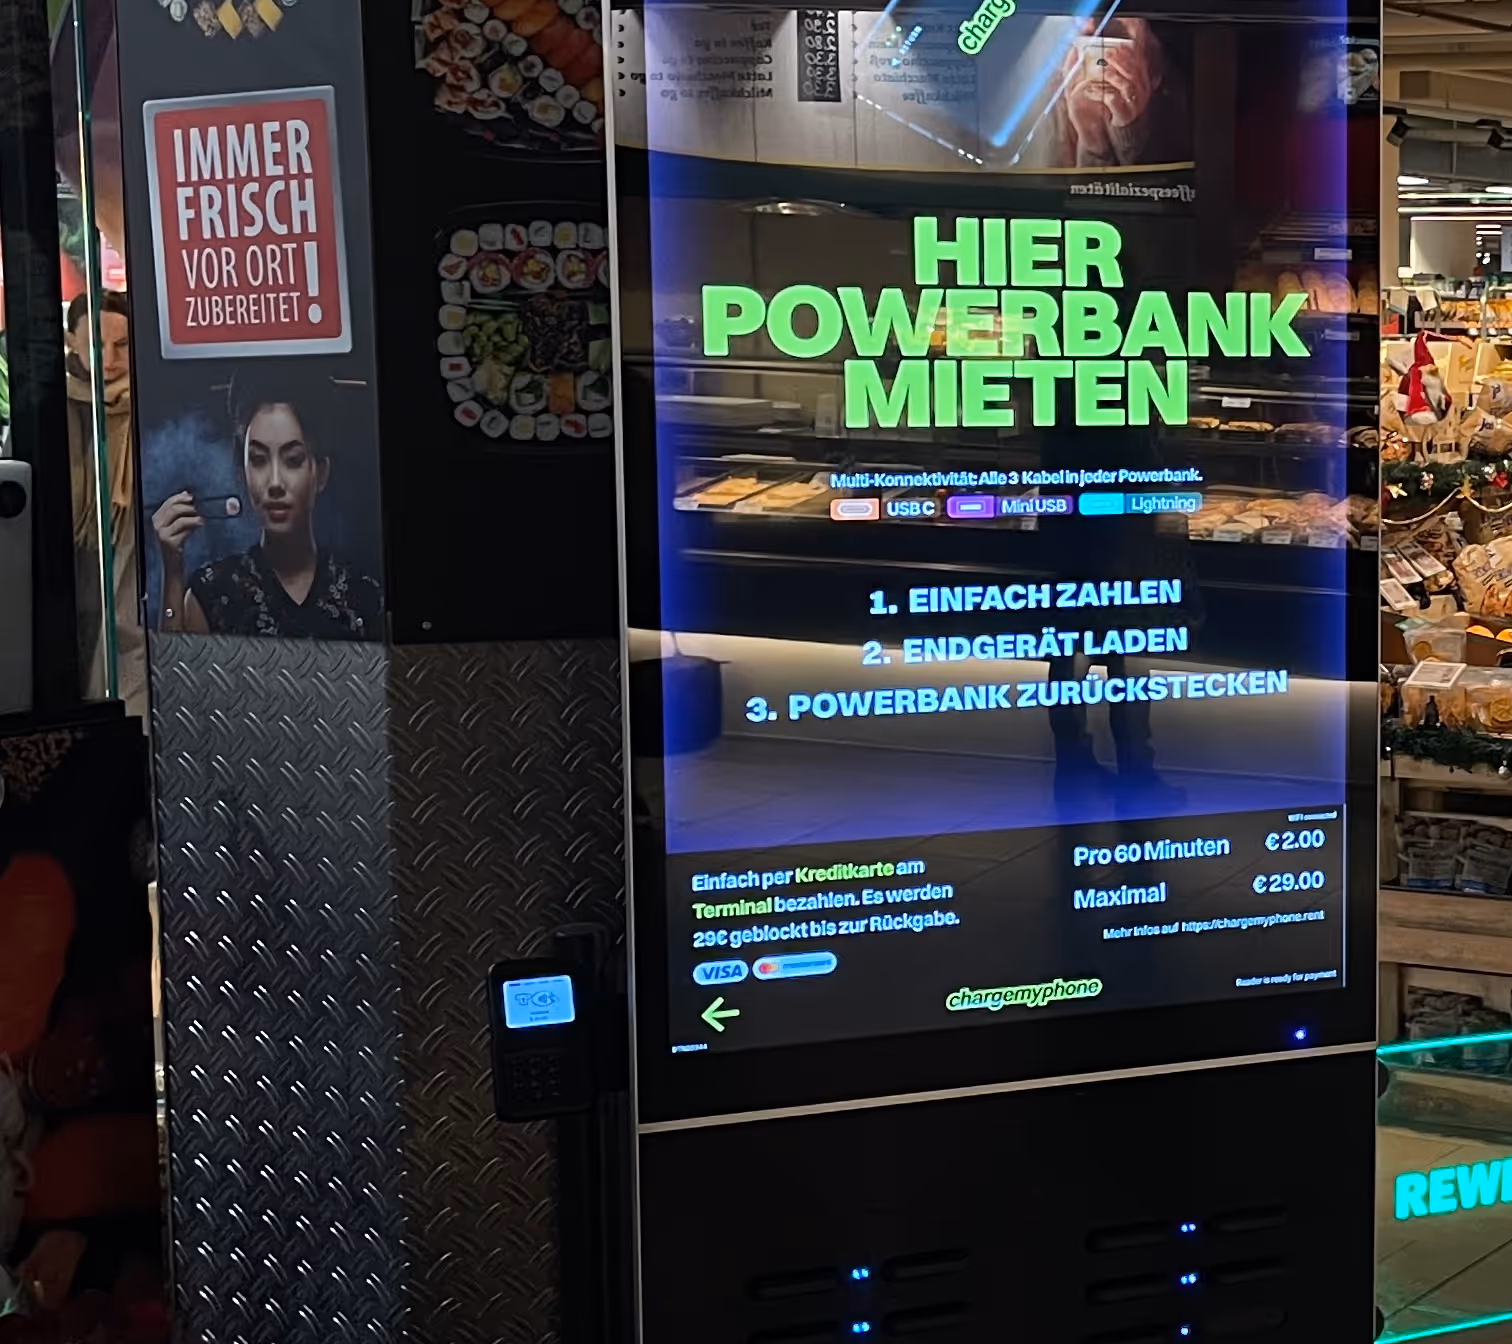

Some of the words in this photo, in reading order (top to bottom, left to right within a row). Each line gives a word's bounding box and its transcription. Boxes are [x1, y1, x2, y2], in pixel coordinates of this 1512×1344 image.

[173, 119, 313, 183] IMMER
[176, 177, 317, 242] FRISCH
[182, 247, 239, 290] VOR
[245, 243, 298, 286] ORT
[913, 215, 1123, 288] HIER
[185, 290, 302, 329] ZUBEREITET
[702, 285, 1311, 359] POWERBANK
[844, 359, 1188, 429] MIETEN
[830, 472, 977, 488] Multi-Konnektivität:
[978, 471, 1008, 485] Alle
[1008, 472, 1019, 485] 3
[1021, 470, 1065, 484] Kabel
[1065, 470, 1079, 484] in
[1079, 470, 1117, 486] jeder
[1118, 468, 1203, 484] Powerbank.
[887, 501, 918, 516] USB
[921, 501, 935, 515] C
[1002, 498, 1033, 513] Mini
[1033, 497, 1068, 512] USB
[1132, 496, 1197, 515] Lightning
[868, 590, 898, 616] 1.
[908, 583, 1052, 614] EINFACH
[1056, 578, 1182, 608] ZAHLEN
[862, 641, 892, 666] 2.
[902, 628, 1078, 664] ENDGERÄT
[1083, 627, 1188, 656] LADEN
[745, 697, 778, 723] 3.
[789, 683, 1011, 720] POWERBANK
[1017, 669, 1288, 709] ZURÜCKSTECKEN
[1073, 846, 1112, 866] Pro
[1114, 842, 1142, 863] 60
[1143, 837, 1231, 862] Minuten
[692, 870, 760, 892] Einfach
[761, 868, 794, 890] per
[795, 861, 895, 883] Kreditkarte
[895, 859, 925, 875] am
[692, 897, 772, 919] Terminal
[773, 891, 861, 913] bezahlen.
[861, 888, 884, 905] Es
[885, 883, 954, 902] werden
[1073, 882, 1168, 910] Maximal
[692, 933, 728, 948] 29€
[728, 924, 809, 949] geblockt
[810, 920, 837, 937] bis
[838, 918, 868, 934] zur
[869, 910, 960, 933] Rückgabe.
[1103, 927, 1132, 940] Mehr
[701, 964, 743, 980] VISA
[948, 980, 1100, 1008] chargemyphone
